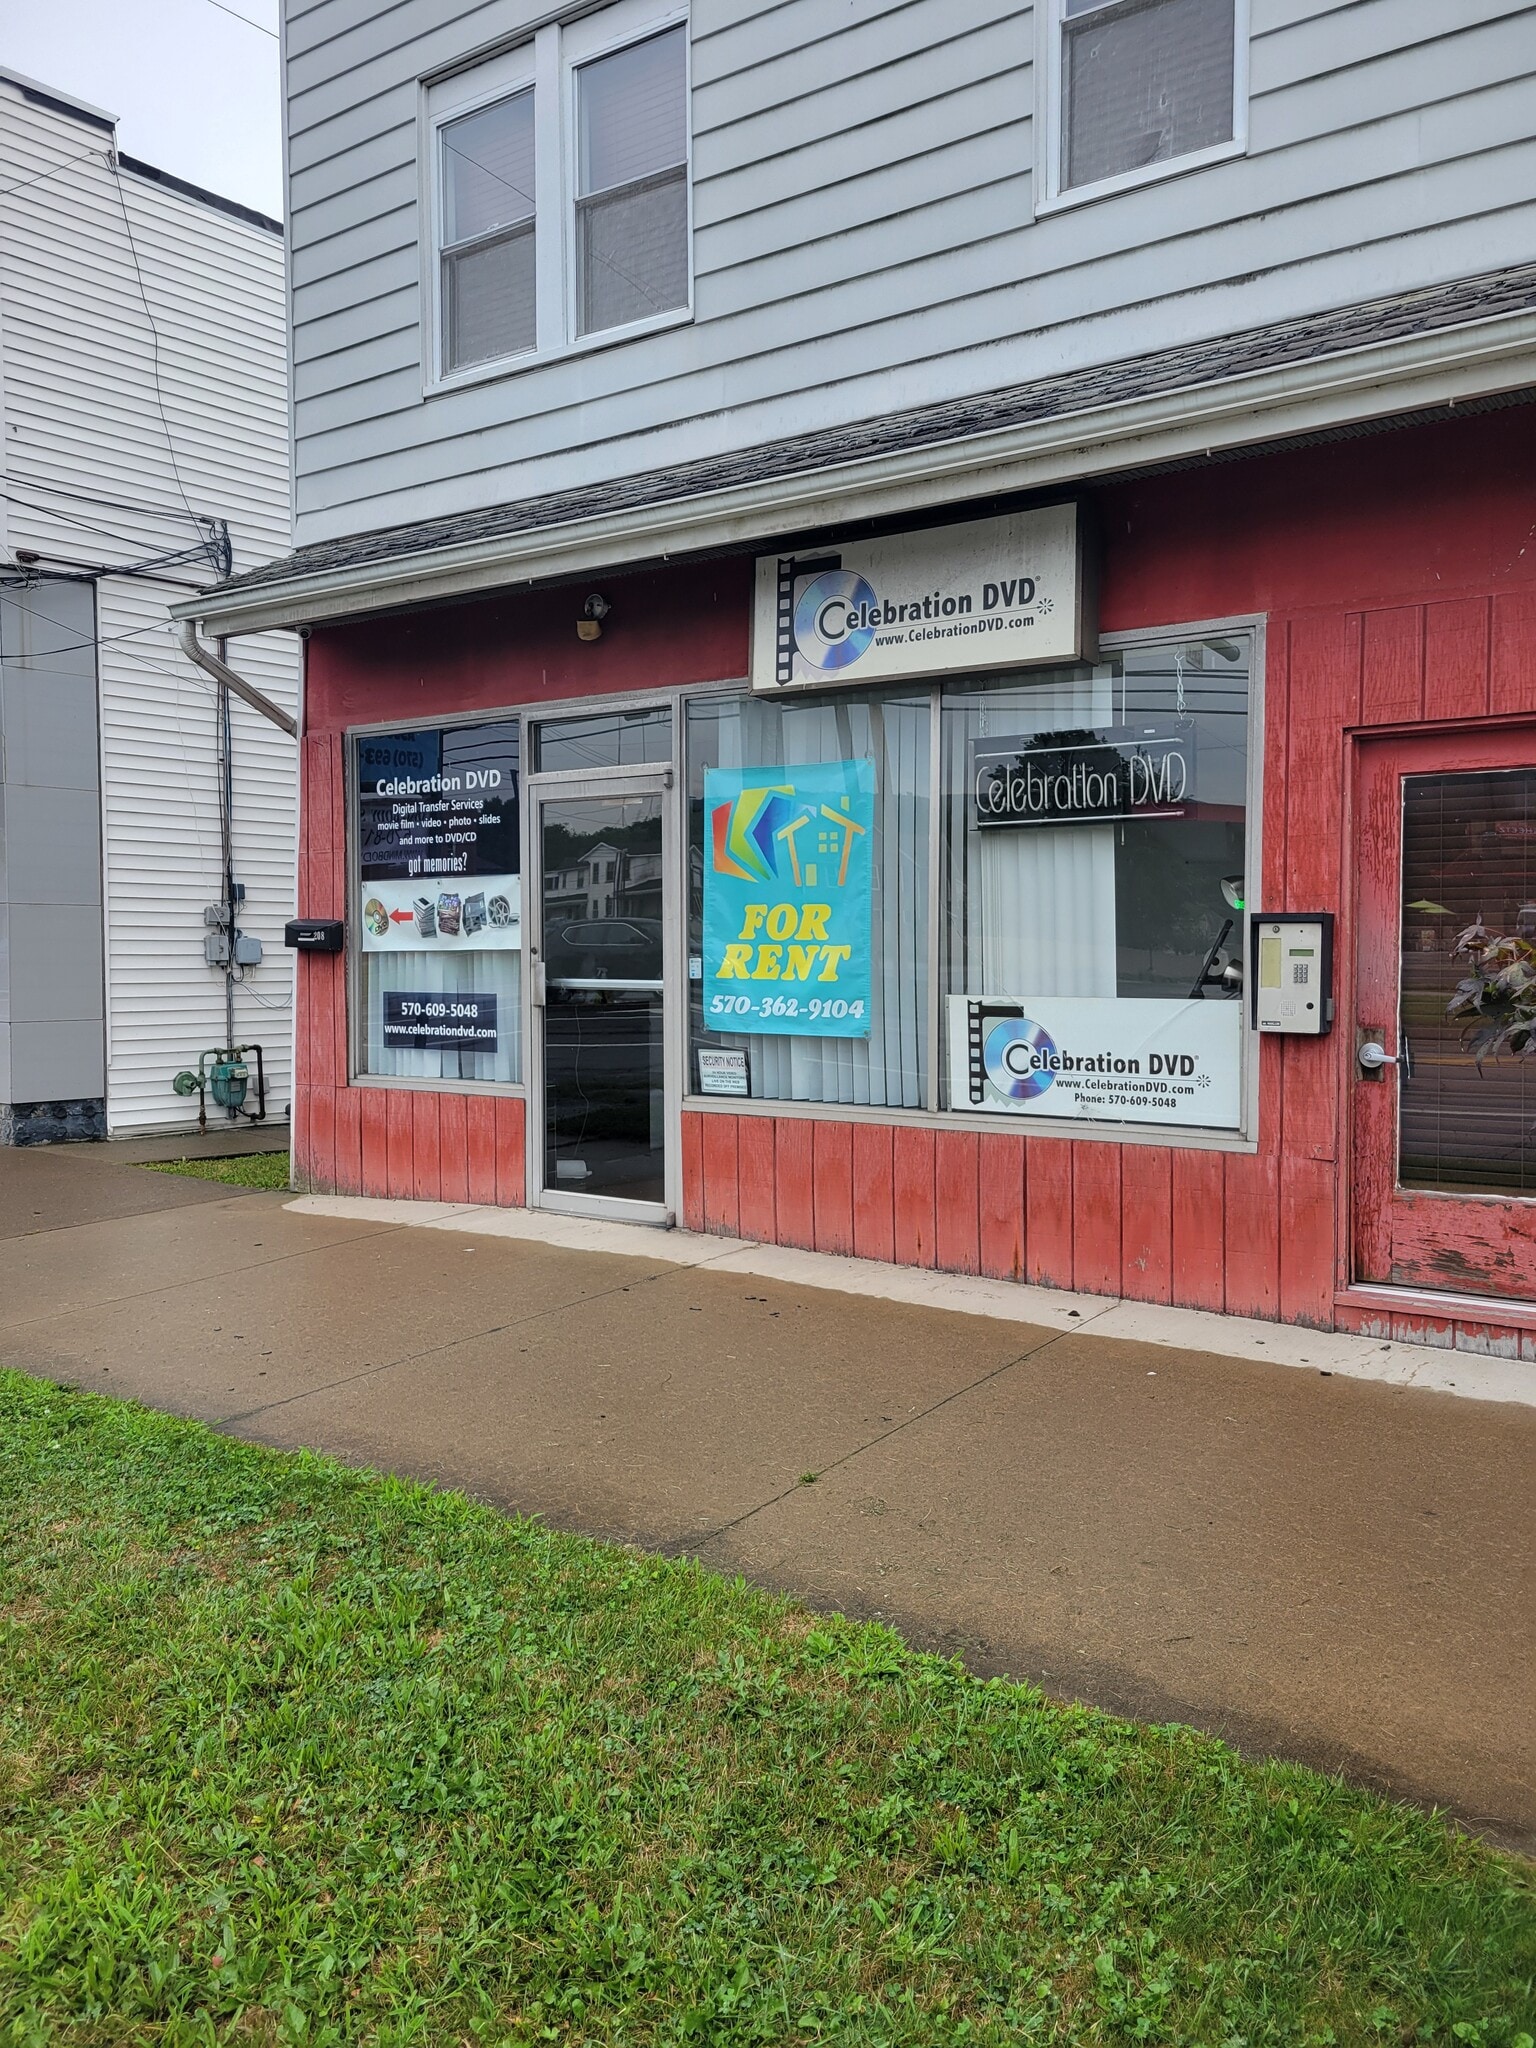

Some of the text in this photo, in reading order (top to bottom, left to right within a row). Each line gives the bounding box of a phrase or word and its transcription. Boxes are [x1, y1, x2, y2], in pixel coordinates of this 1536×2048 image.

[819, 591, 972, 639] Celebration
[875, 614, 1034, 646] www.CelebrationDVD.com
[376, 769, 501, 796] Celebration DVD
[1130, 752, 1186, 805] DVD
[392, 803, 417, 817] Digital
[418, 800, 449, 813] Transfer
[451, 798, 484, 811] Services
[377, 815, 501, 831] movie film video photo slides
[399, 831, 477, 845] and more to DVD/CD
[408, 852, 468, 876] got memories?
[738, 903, 832, 941] FOR
[313, 931, 325, 940] 208
[715, 944, 851, 982] RENT
[401, 1002, 478, 1018] 570-609-5048
[709, 995, 865, 1020] 570-362-9104
[384, 1023, 497, 1038] www.celebrationdvd.com
[702, 1055, 745, 1068] SECURITY NOTICE
[1006, 1043, 1140, 1075] Celebration
[1055, 1078, 1195, 1095] www.CelebrationDVD.com
[1074, 1092, 1177, 1108] Phone: 570-609-5048
